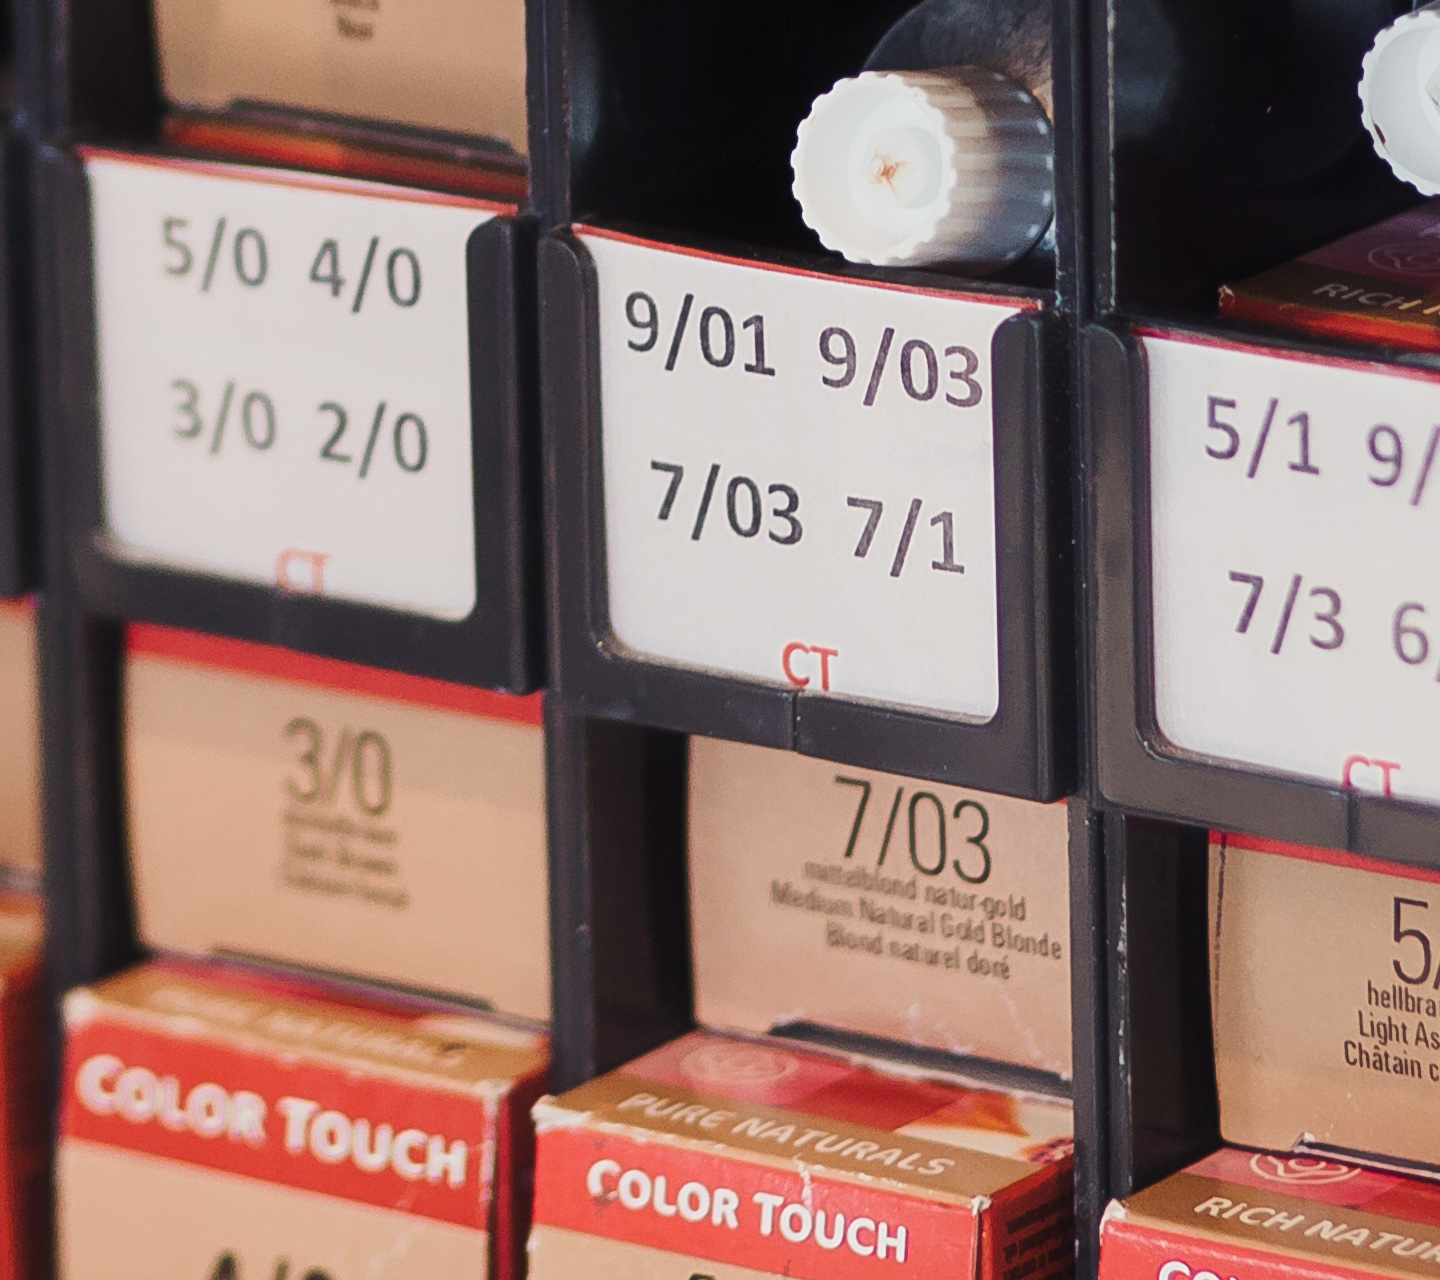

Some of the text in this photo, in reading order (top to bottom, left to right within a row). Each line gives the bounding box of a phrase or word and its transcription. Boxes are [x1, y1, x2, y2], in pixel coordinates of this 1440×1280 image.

[161, 216, 423, 315] 5/0 4/0
[623, 290, 985, 409] 9/01 9/03
[168, 376, 431, 481] 3/0 2/0
[1203, 392, 1324, 481] 5/1
[649, 459, 967, 580] 7/03 7/1
[1226, 568, 1347, 657] 7/3
[781, 641, 840, 692] CT
[282, 716, 393, 820] 3/0
[832, 773, 994, 885] 7/03
[966, 949, 1011, 981] doré
[990, 920, 1063, 961] Blonde
[1343, 1038, 1423, 1080] Châtain
[1357, 1009, 1409, 1051] Light
[74, 1051, 468, 1190] COLOR TOUCH
[618, 1091, 957, 1179] PURE NATURALS
[586, 1158, 910, 1264] COLOR TOUCH
[1193, 1195, 1308, 1232] RICH
